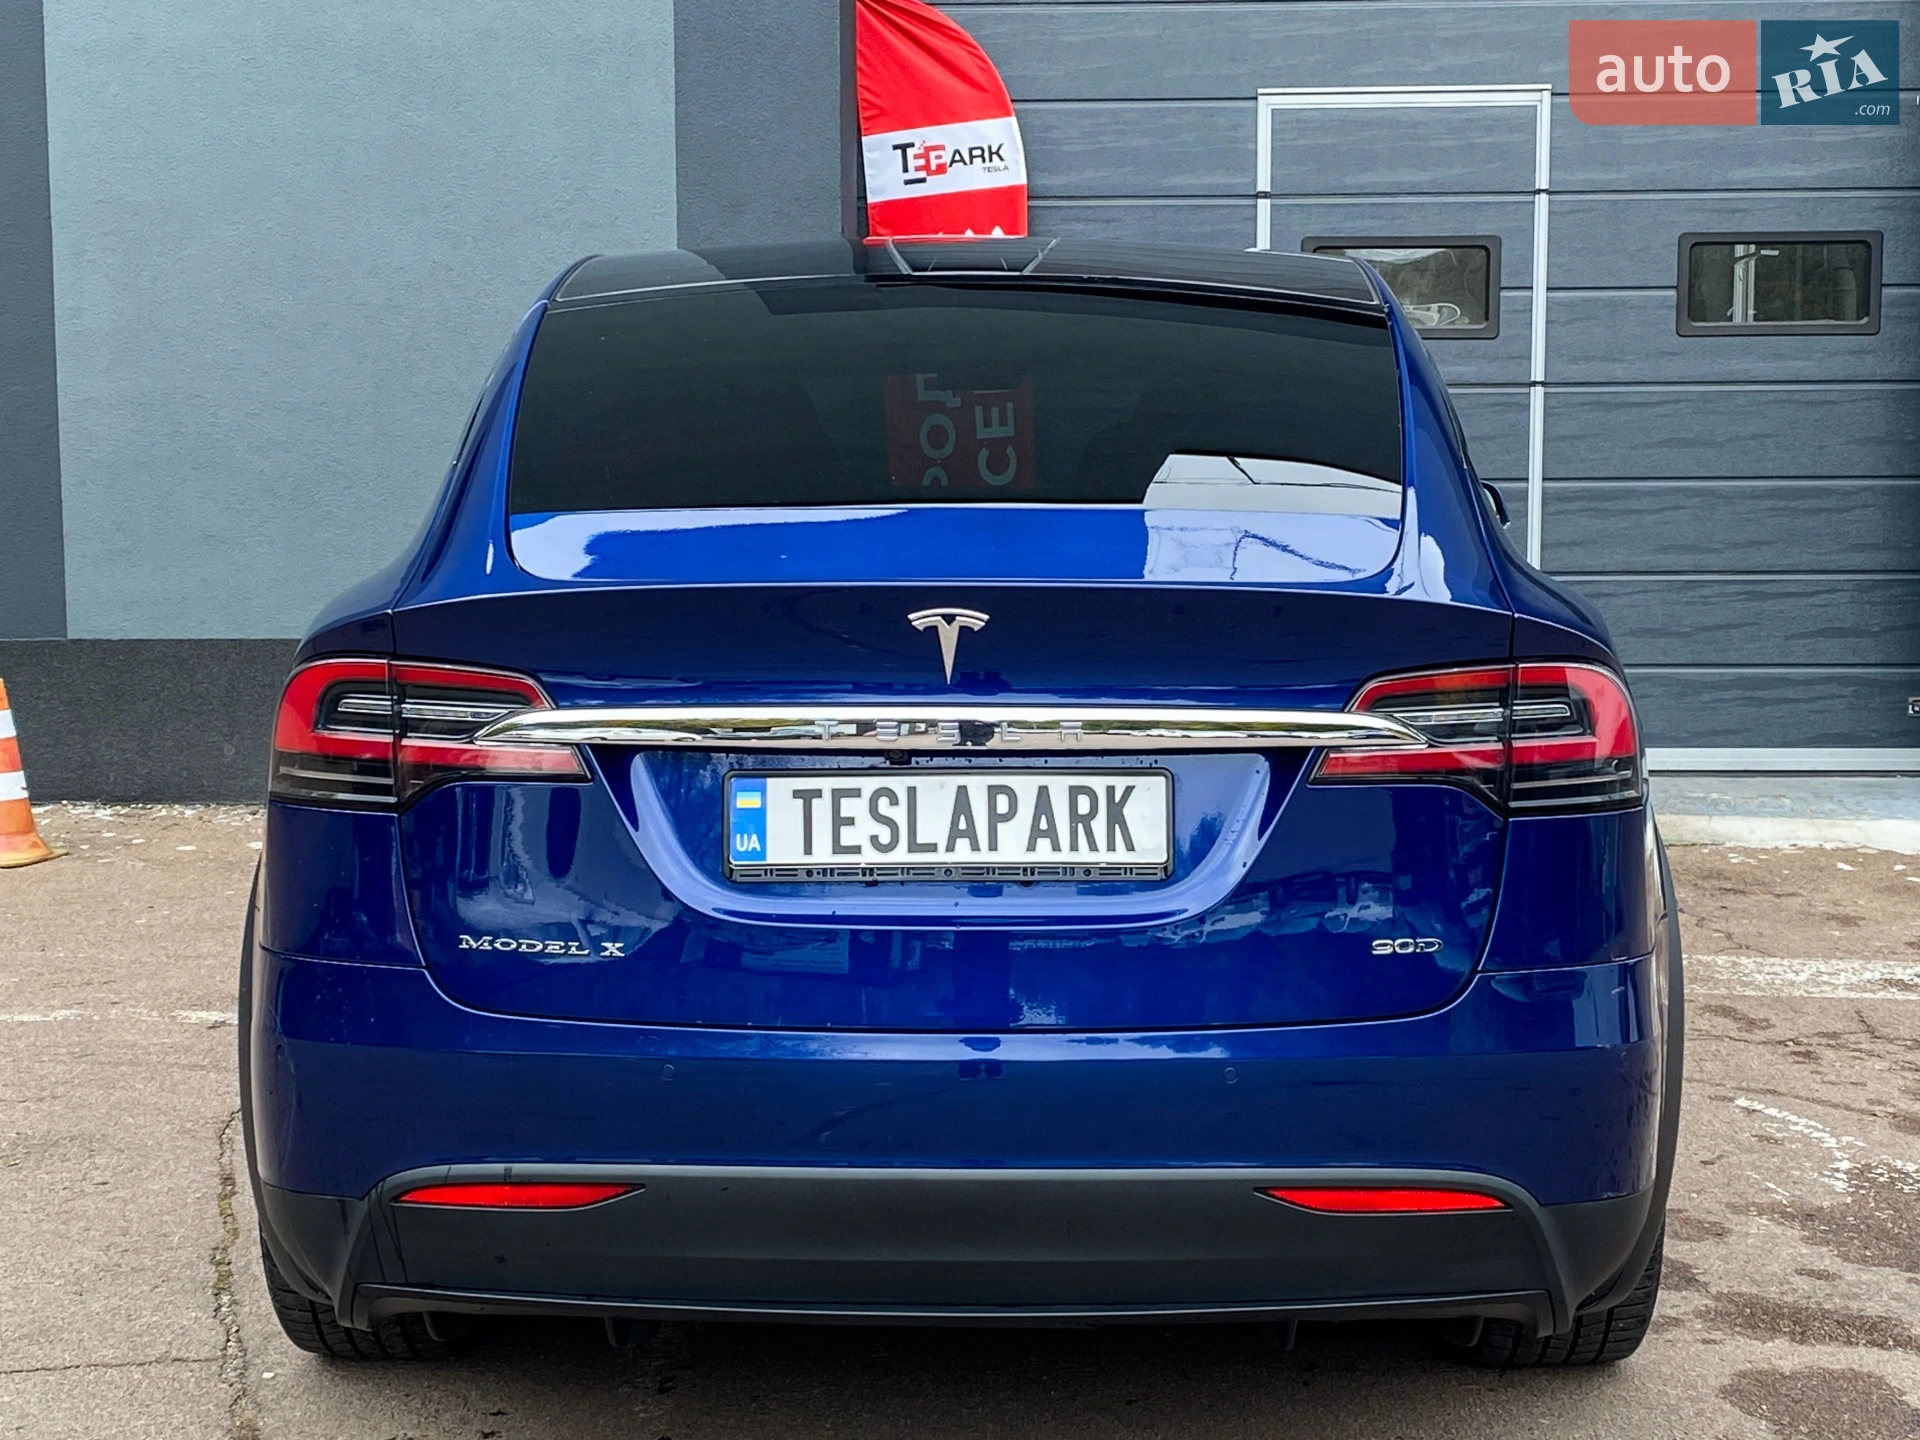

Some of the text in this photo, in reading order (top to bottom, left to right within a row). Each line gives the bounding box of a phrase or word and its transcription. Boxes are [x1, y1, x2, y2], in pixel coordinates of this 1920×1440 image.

[982, 165, 1009, 173] TESLA
[792, 784, 1136, 856] TESLAPARK
[735, 833, 761, 852] UA
[458, 935, 626, 957] MODEL X
[1371, 938, 1444, 955] 90D
